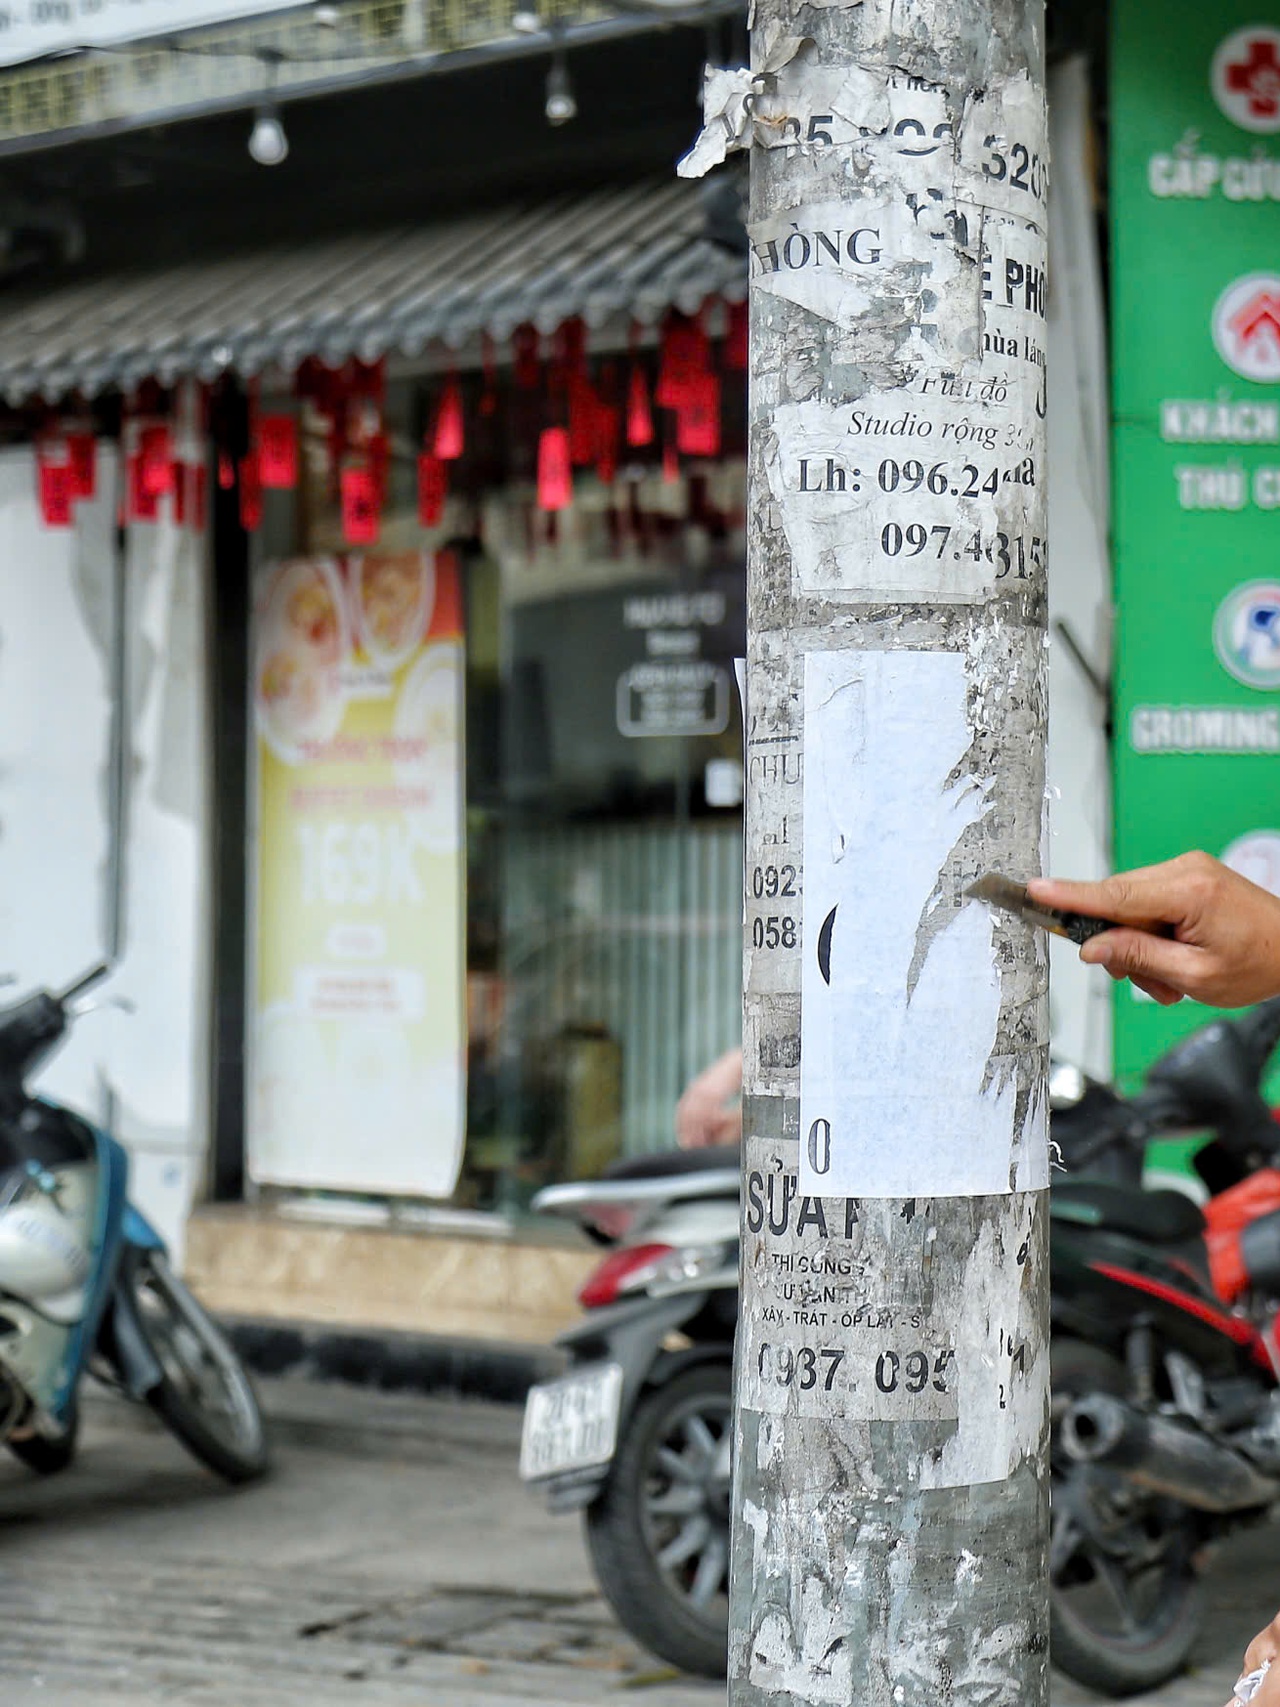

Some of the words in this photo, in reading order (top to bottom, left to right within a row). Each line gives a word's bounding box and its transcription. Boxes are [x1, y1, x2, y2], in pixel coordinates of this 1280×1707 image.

[847, 410, 933, 438] Studio
[941, 418, 998, 450] rộng
[797, 459, 861, 493] Lh:
